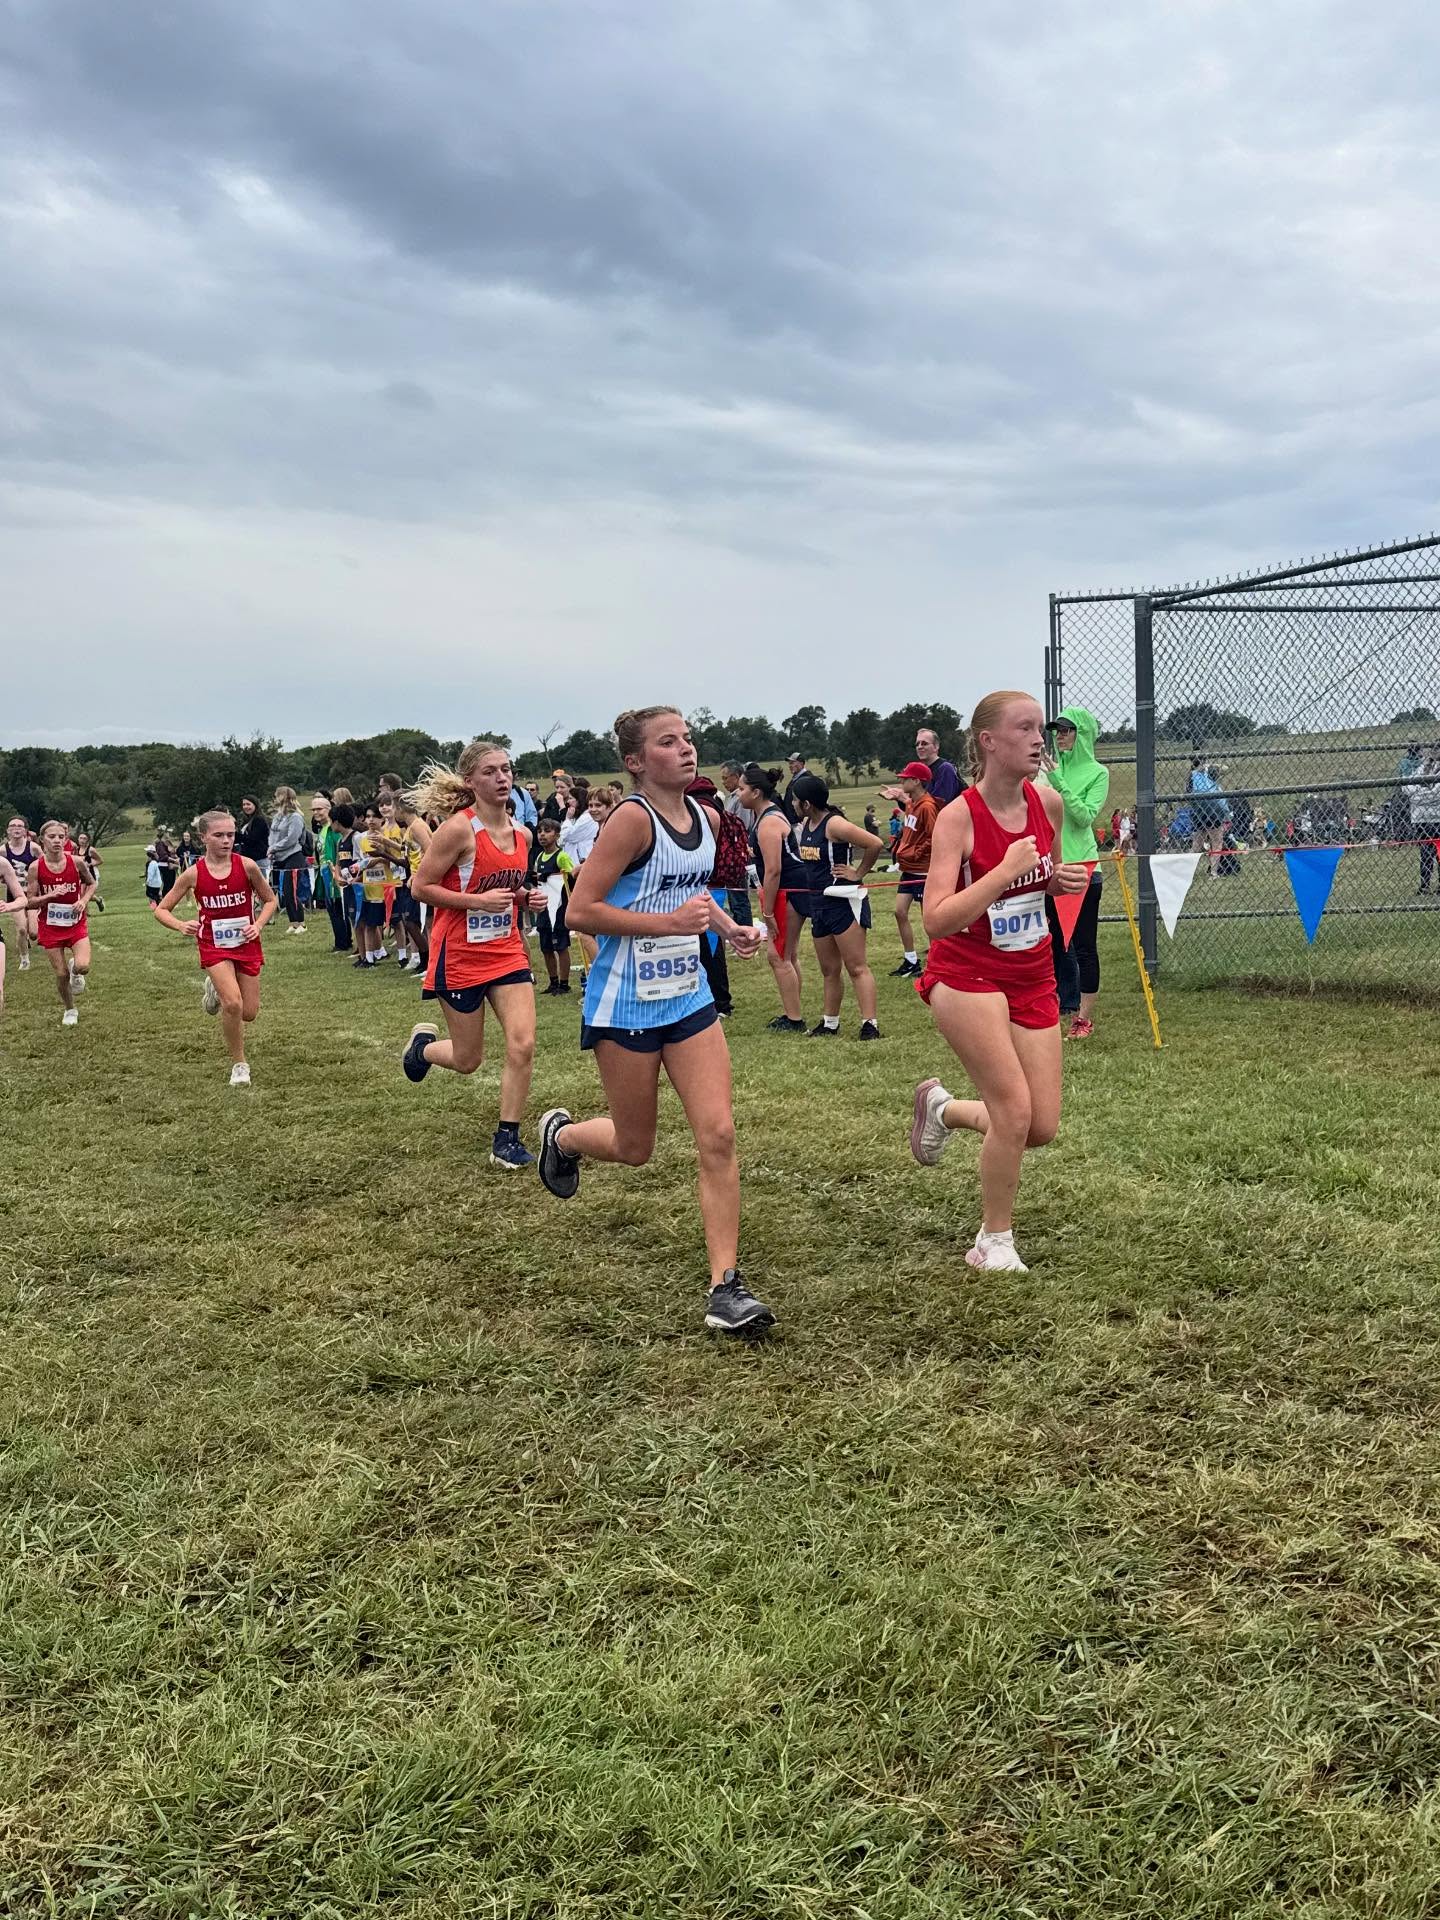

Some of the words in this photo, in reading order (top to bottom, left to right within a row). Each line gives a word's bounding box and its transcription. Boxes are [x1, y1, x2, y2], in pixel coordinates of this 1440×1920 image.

[202, 891, 246, 909] RAIDERS
[468, 913, 512, 930] 9298
[992, 910, 1044, 936] 9071
[639, 954, 699, 981] 8953
